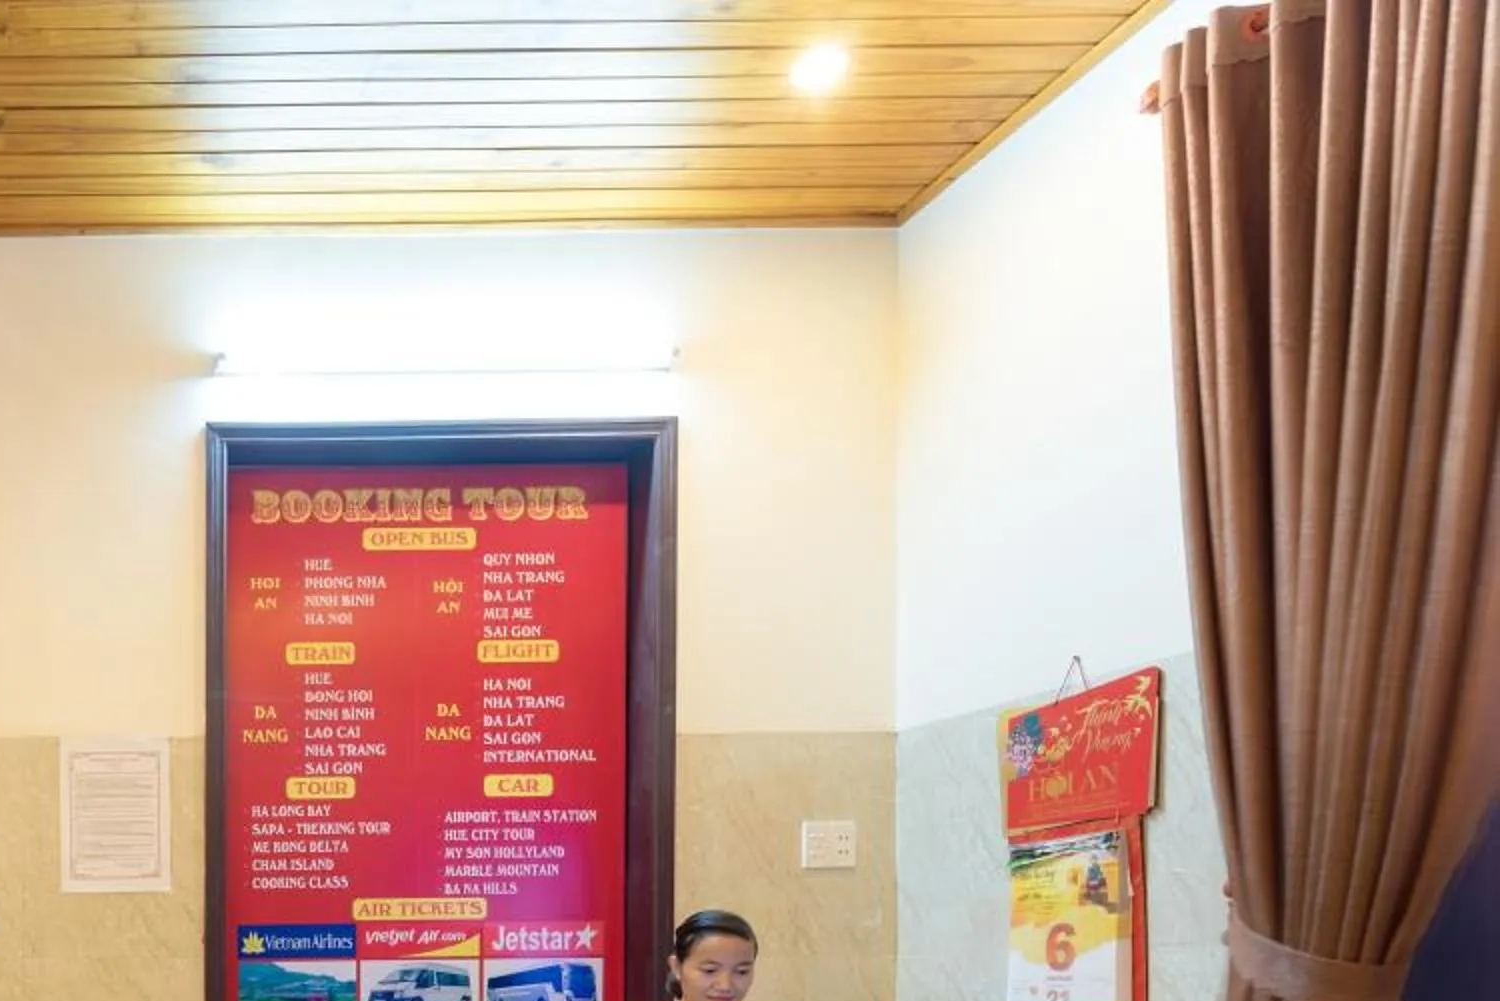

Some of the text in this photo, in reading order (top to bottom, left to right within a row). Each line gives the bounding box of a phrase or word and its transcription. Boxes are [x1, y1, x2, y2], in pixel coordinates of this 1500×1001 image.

[252, 487, 588, 523] BOOKING TOUR
[371, 531, 468, 546] OPEN BUS
[304, 558, 333, 571] HUE
[483, 552, 555, 567] QUY NHON
[304, 575, 387, 589] PHONG NHA
[483, 570, 565, 584] NHA TRANG
[304, 594, 339, 607] NINH
[507, 589, 534, 602] LAT
[254, 597, 277, 609] AN
[436, 601, 461, 614] AN
[304, 612, 353, 625] HA NOI
[511, 607, 533, 620] ME
[483, 625, 541, 639] SAI GON
[291, 646, 351, 661] TRAIN
[481, 643, 554, 659] FLIGHT
[304, 672, 333, 685] HUE
[483, 678, 532, 691] HA NOI
[348, 689, 373, 702] HOI
[483, 696, 565, 709] NHA TRANG
[304, 708, 339, 721] NINH
[506, 714, 535, 727] LAT
[243, 729, 289, 743] NANG
[304, 725, 361, 739] LAO CAI
[425, 726, 472, 741] NANG
[483, 732, 542, 745] SAI GON
[304, 743, 387, 757] NHA TRANG
[483, 749, 597, 763] INTERNATIONAL
[304, 762, 363, 775] SAI GON
[294, 781, 349, 796] TOUR
[497, 778, 540, 793] CAR
[252, 804, 331, 817] HA LONG BAY
[504, 810, 541, 823] TRAIN
[543, 809, 597, 823] STATION
[252, 823, 285, 836] SAPA
[295, 822, 355, 835] TREKKING
[358, 821, 391, 834] TOUR
[444, 828, 535, 841] HUE CITY TOUR
[252, 840, 349, 853] ME KONG DELTA
[444, 846, 565, 859] MY SON HOLLYLAND
[252, 858, 334, 872] CHAM ISLAND
[444, 864, 559, 877] MARBLE MOUNTAIN
[252, 876, 349, 889] COOKING CLASS
[444, 882, 517, 895] BA NA HILLS
[358, 901, 483, 917] AIR TICKETS
[266, 934, 354, 951] Vietnam Airlines
[492, 925, 573, 951] Jetstar
[1046, 922, 1077, 971] 6
